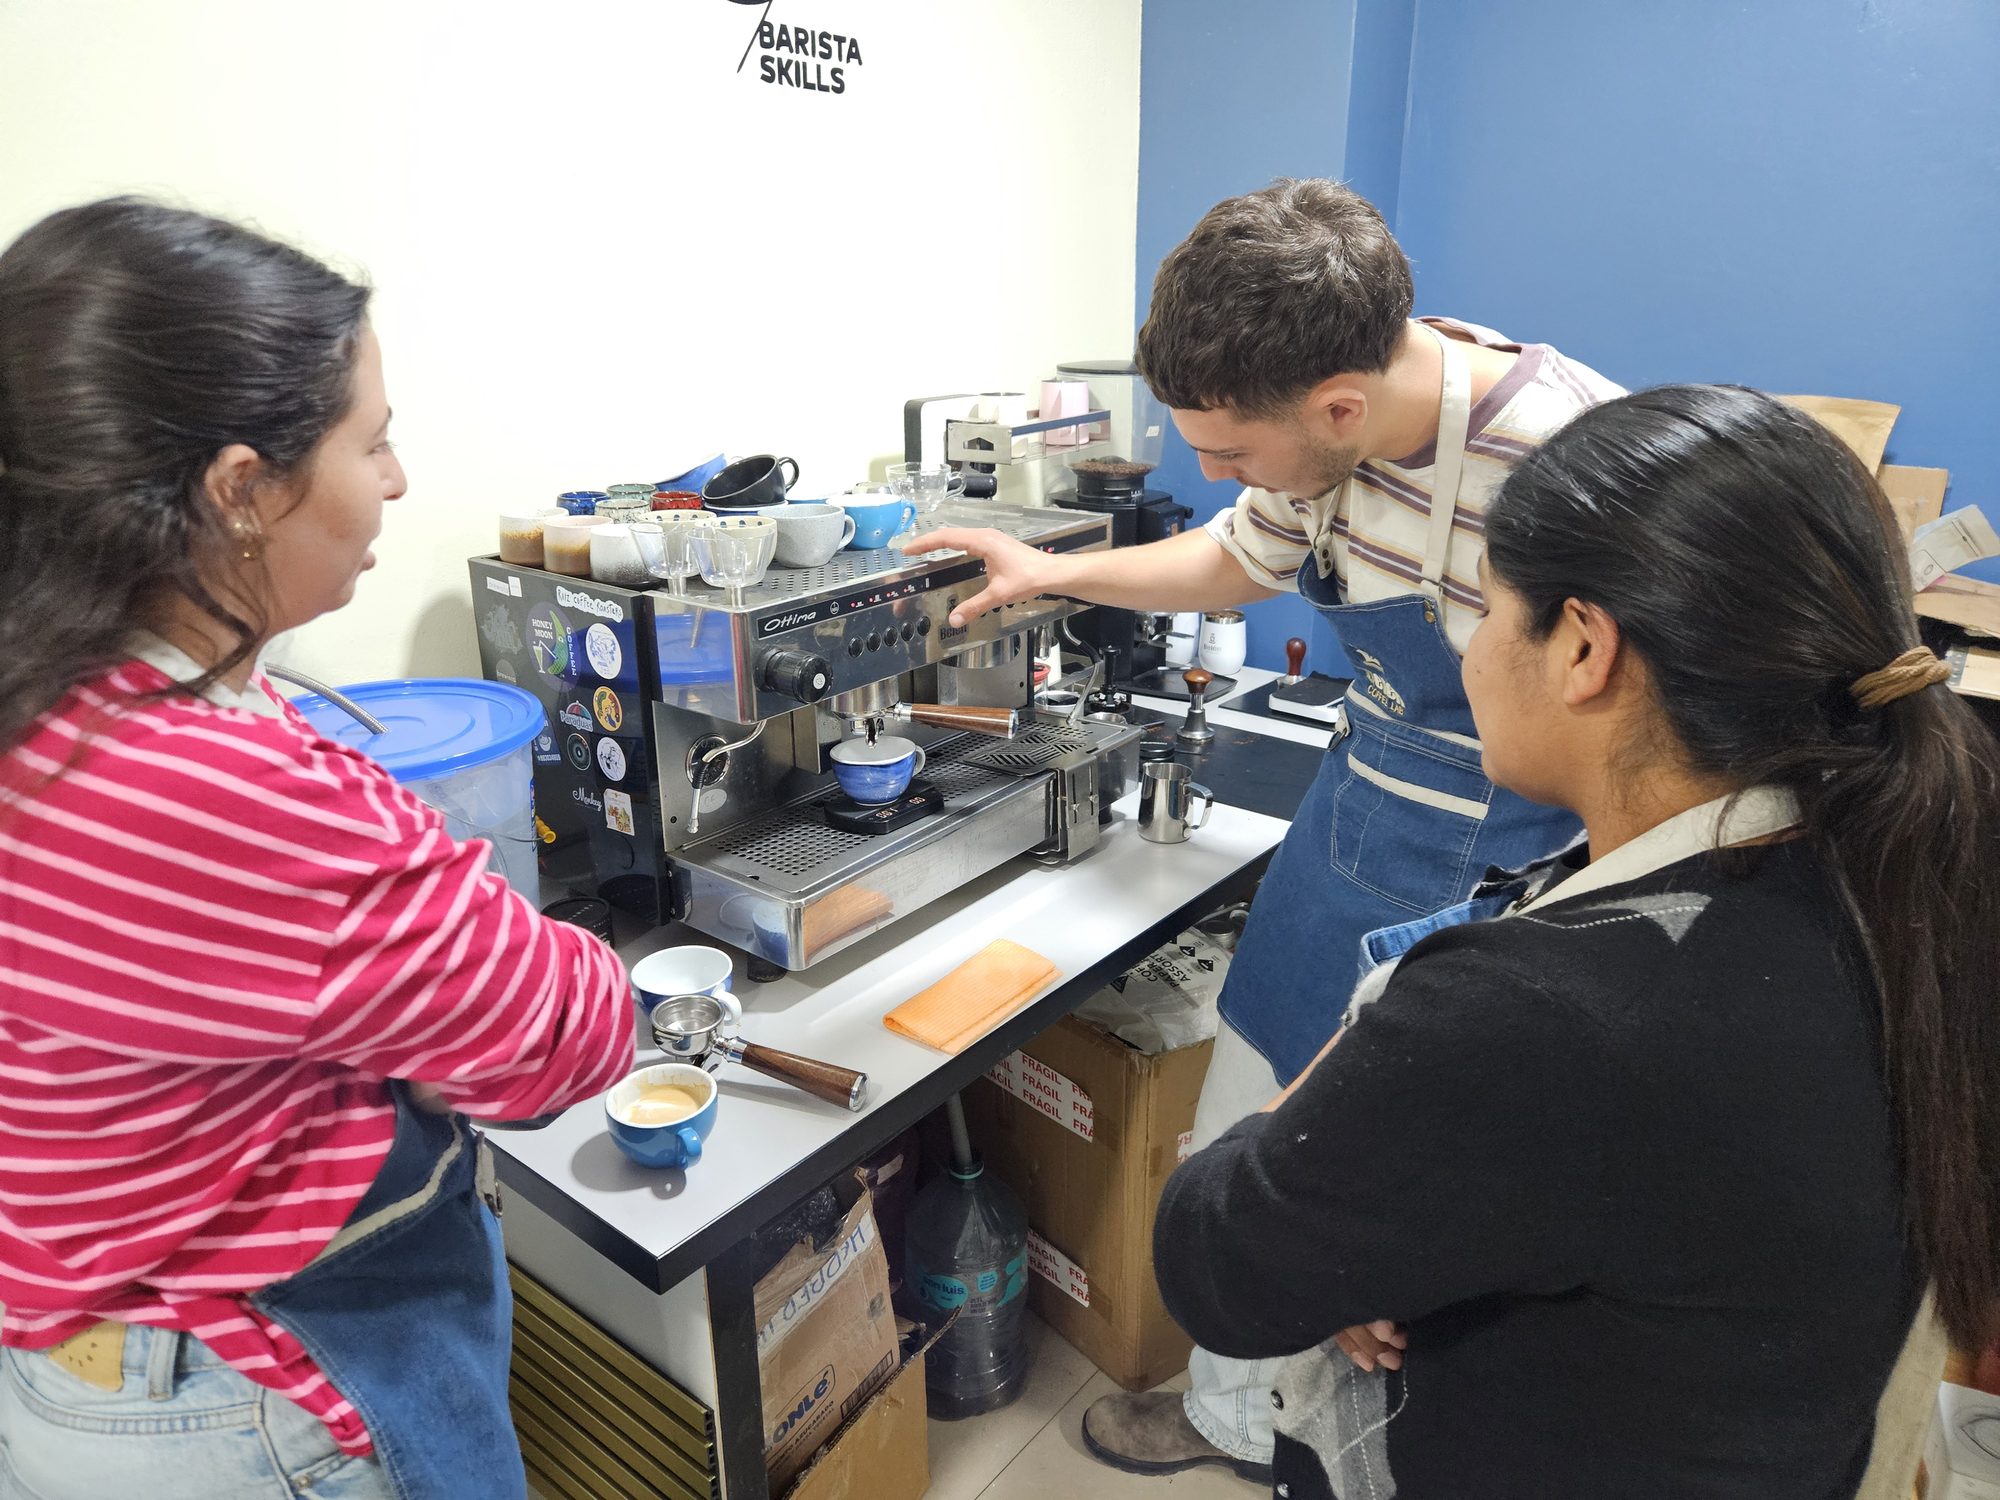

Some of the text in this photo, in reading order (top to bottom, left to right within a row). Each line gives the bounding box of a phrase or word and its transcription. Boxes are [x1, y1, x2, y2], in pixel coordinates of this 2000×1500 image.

[759, 21, 863, 66] BARISTA
[760, 55, 845, 94] SKILLS
[531, 618, 553, 630] HONEY
[764, 611, 817, 632] Ottima
[534, 628, 553, 640] MOON
